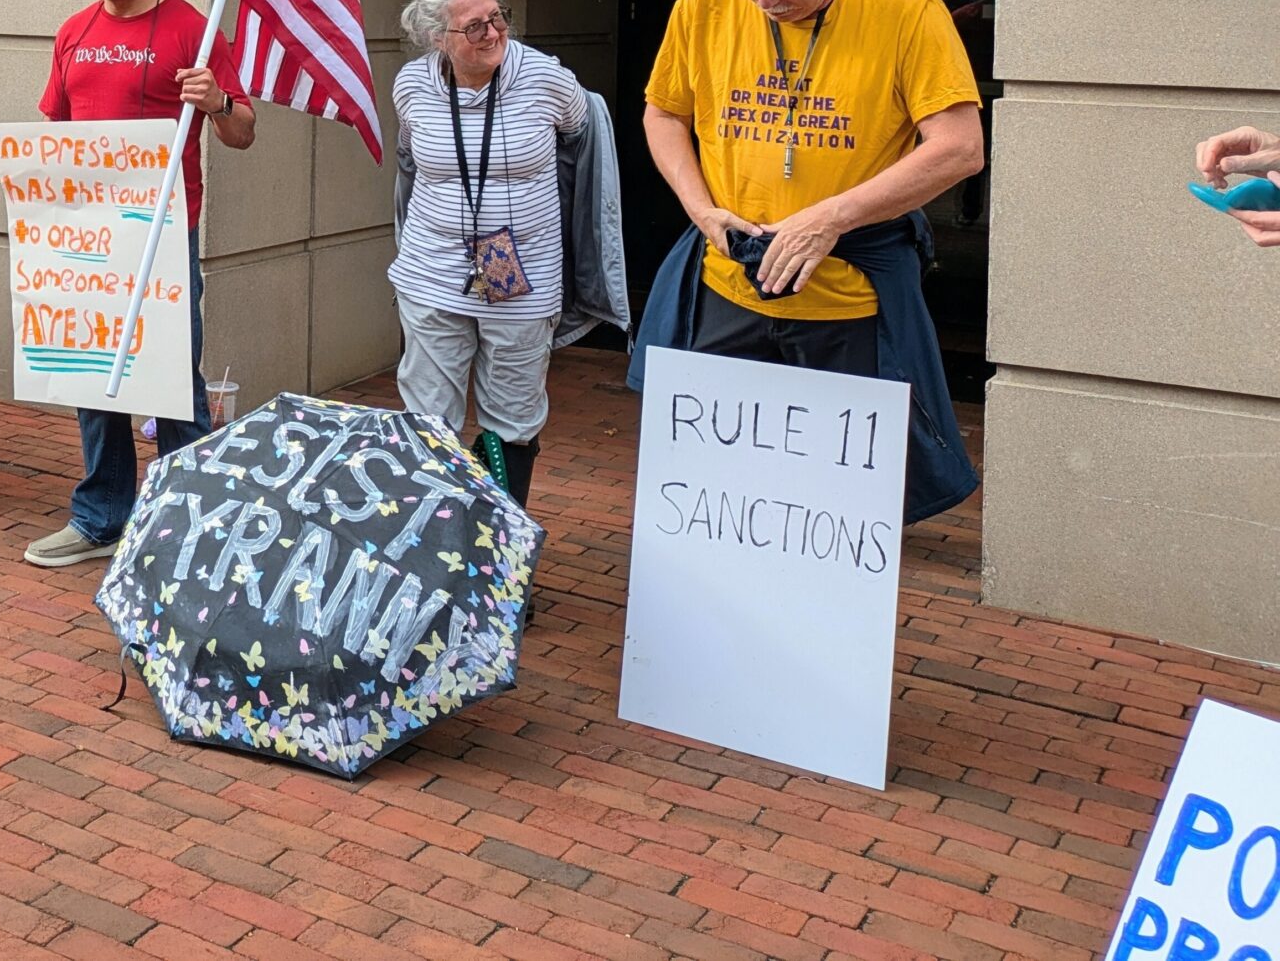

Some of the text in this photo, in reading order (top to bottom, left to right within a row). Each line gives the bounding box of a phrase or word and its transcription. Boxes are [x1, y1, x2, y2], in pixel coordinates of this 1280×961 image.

[112, 44, 156, 68] People
[775, 58, 800, 73] WE
[756, 74, 813, 92] ARE AT
[731, 89, 835, 111] OR NEAR THE
[721, 105, 851, 131] APEX OF A GREAT
[155, 277, 183, 304] be
[672, 393, 879, 470] RULE 11
[655, 482, 891, 574] SANCTIONS
